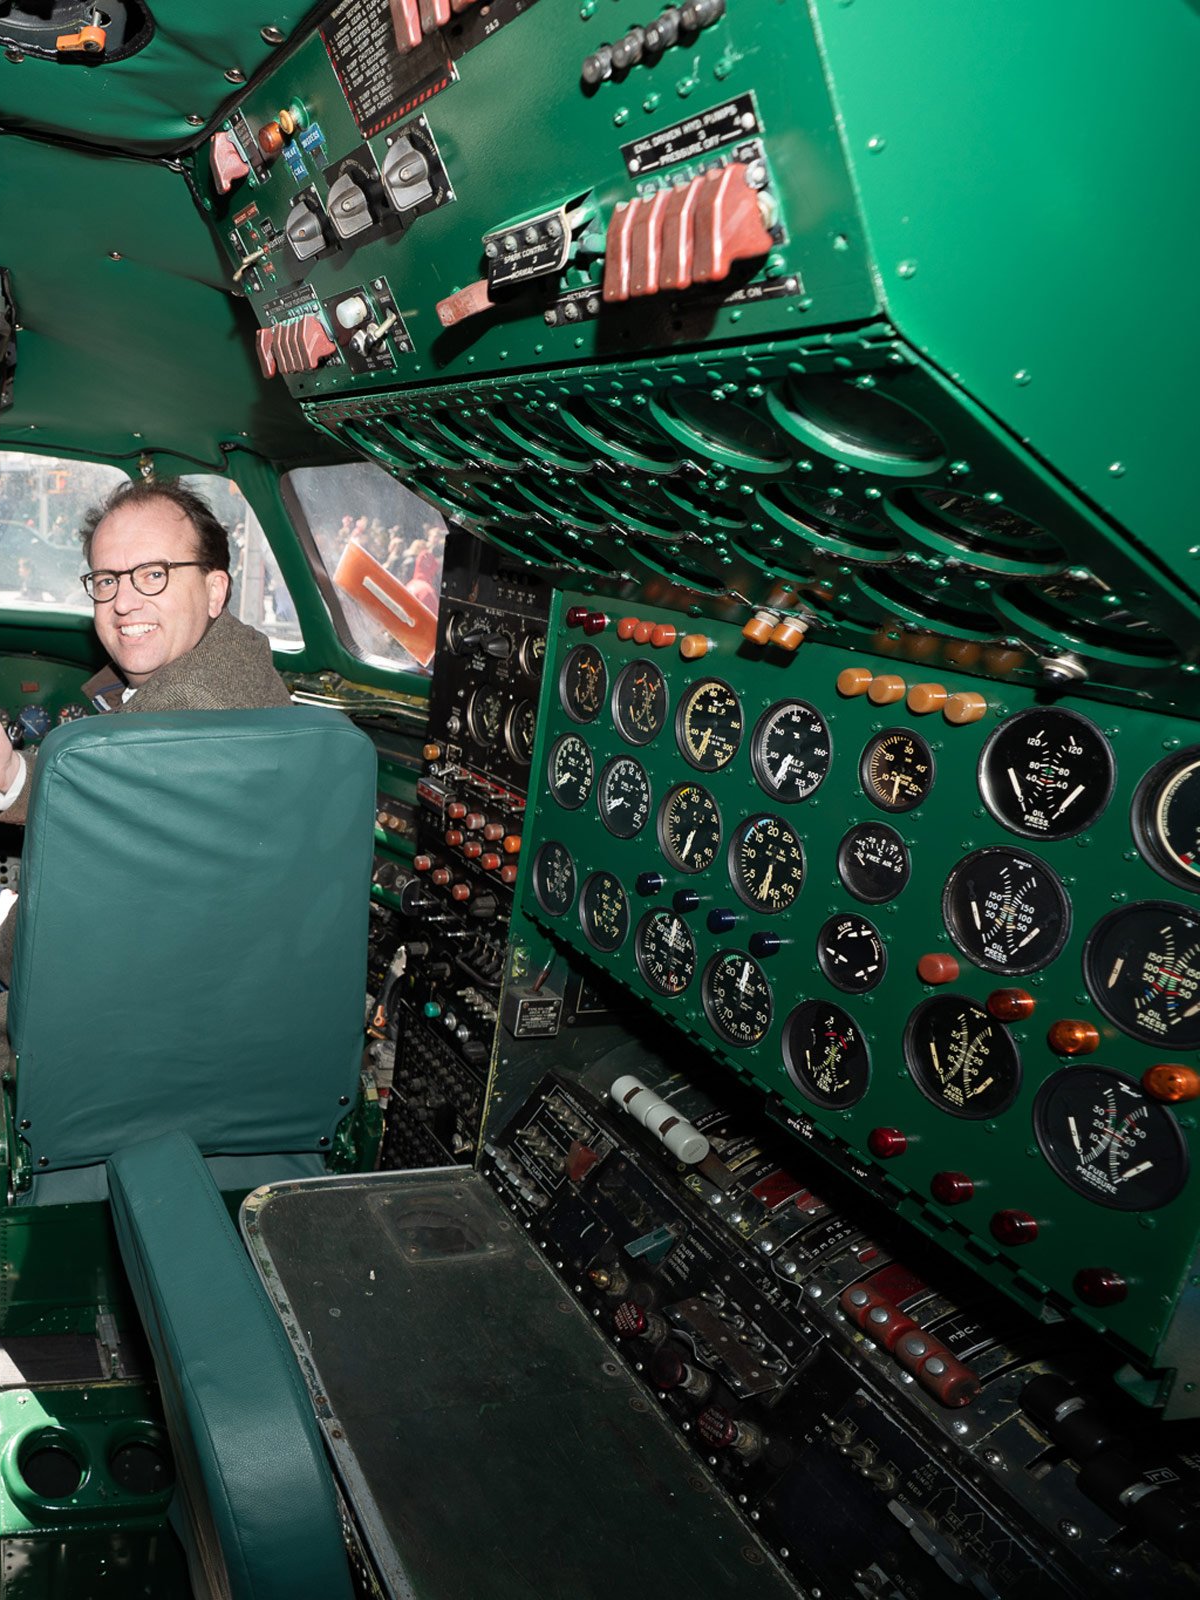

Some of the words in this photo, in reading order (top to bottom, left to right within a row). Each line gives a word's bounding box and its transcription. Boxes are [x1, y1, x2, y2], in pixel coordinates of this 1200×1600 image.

[337, 34, 350, 49] SPEED
[350, 17, 369, 38] BETWEEN
[341, 43, 352, 56] CABIN
[353, 27, 371, 46] HEATERS
[358, 38, 370, 52] DUMP
[347, 59, 357, 72] DUMP
[353, 75, 364, 87] DUMP
[651, 127, 682, 147] DRIVEN
[703, 103, 738, 126] PUMPS
[698, 130, 706, 140] 3
[659, 142, 704, 166] PRESSURE
[703, 134, 721, 150] OFF
[665, 143, 673, 153] 2
[504, 254, 522, 264] SPARK
[522, 243, 548, 257] CONTROL
[746, 287, 762, 297] ON
[1027, 737, 1040, 747] 120
[814, 748, 826, 756] 260
[904, 746, 914, 755] 30
[1068, 746, 1083, 755] 120
[916, 764, 925, 772] 40
[1029, 761, 1040, 770] 80
[807, 771, 818, 780] 300
[882, 773, 889, 781] 10
[1025, 773, 1037, 782] 40
[1059, 768, 1070, 777] 80
[795, 778, 806, 787] 325
[909, 783, 919, 791] 50
[1056, 781, 1068, 790] 40
[1170, 772, 1193, 796] OPERATION
[691, 795, 700, 803] 20
[704, 799, 713, 809] 25
[1032, 809, 1045, 819] OIL
[767, 826, 779, 837] 20
[755, 833, 764, 843] 15
[782, 831, 794, 844] 25
[693, 853, 702, 861] 45
[748, 848, 757, 858] 10
[866, 853, 881, 864] FREE
[882, 860, 892, 868] AIR
[750, 870, 756, 878] 5
[791, 867, 802, 879] 35
[768, 888, 780, 899] 45
[781, 883, 794, 895] 40
[989, 891, 1002, 902] 150
[985, 900, 998, 910] 100
[1020, 904, 1035, 914] 150
[985, 910, 995, 919] 50
[1018, 913, 1032, 924] 100
[837, 921, 852, 932] SLOW
[1017, 923, 1027, 932] 50
[991, 942, 1004, 952] OIL
[1147, 952, 1163, 963] 150
[654, 962, 662, 972] 70
[726, 965, 736, 976] 20
[1143, 963, 1160, 974] 100
[670, 975, 678, 984] 60
[1142, 973, 1155, 983] 50
[1181, 978, 1198, 990] 100
[718, 988, 725, 998] 10
[1179, 989, 1192, 999] 50
[724, 1007, 733, 1018] 70
[756, 1012, 767, 1023] 50
[1147, 1009, 1162, 1021] OIL
[740, 1022, 750, 1034] 60
[951, 1030, 961, 1039] 30
[949, 1043, 958, 1052] 20
[979, 1045, 990, 1055] 30
[974, 1056, 983, 1066] 20
[971, 1067, 978, 1076] 10
[947, 1083, 963, 1096] FUEL
[1092, 1105, 1105, 1116] 30
[1093, 1119, 1104, 1130] 20
[1089, 1132, 1099, 1142] 10
[1133, 1128, 1147, 1139] 30
[1124, 1136, 1136, 1147] 20
[1120, 1150, 1130, 1160] 10
[1087, 1164, 1109, 1181] FUEL
[1076, 1164, 1118, 1195] PRESSURE
[918, 1465, 936, 1481] FUEL
[905, 1480, 923, 1497] HIGH
